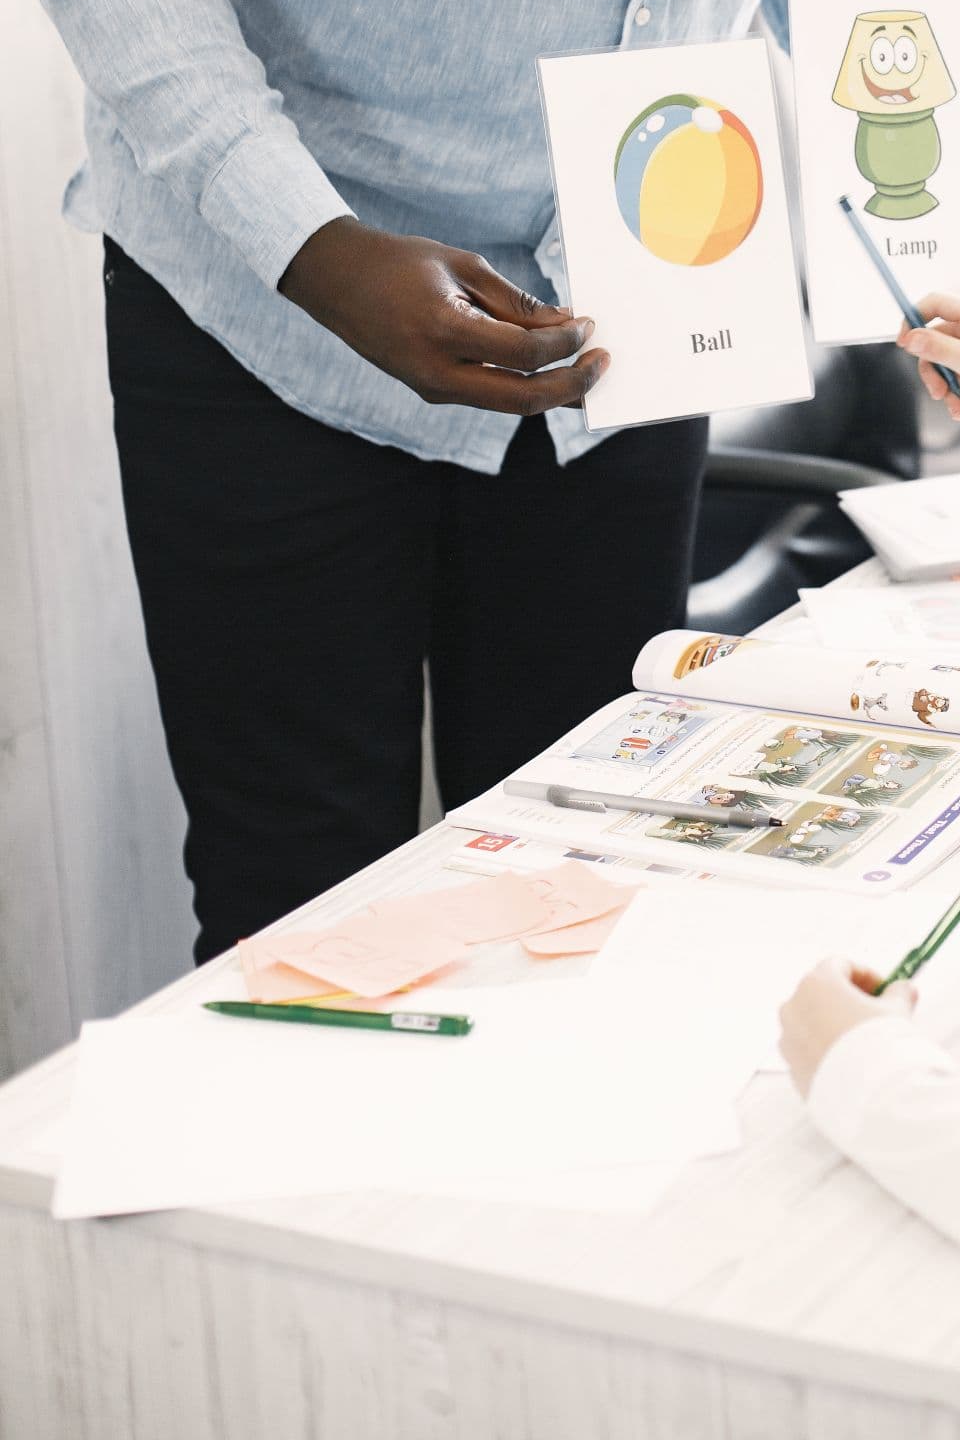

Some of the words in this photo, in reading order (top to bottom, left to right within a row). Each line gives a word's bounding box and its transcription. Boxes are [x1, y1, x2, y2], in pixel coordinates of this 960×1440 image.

[885, 237, 938, 259] Lamp
[690, 329, 733, 354] Ball
[925, 820, 948, 834] That
[477, 837, 503, 850] 15
[898, 838, 926, 859] Those
